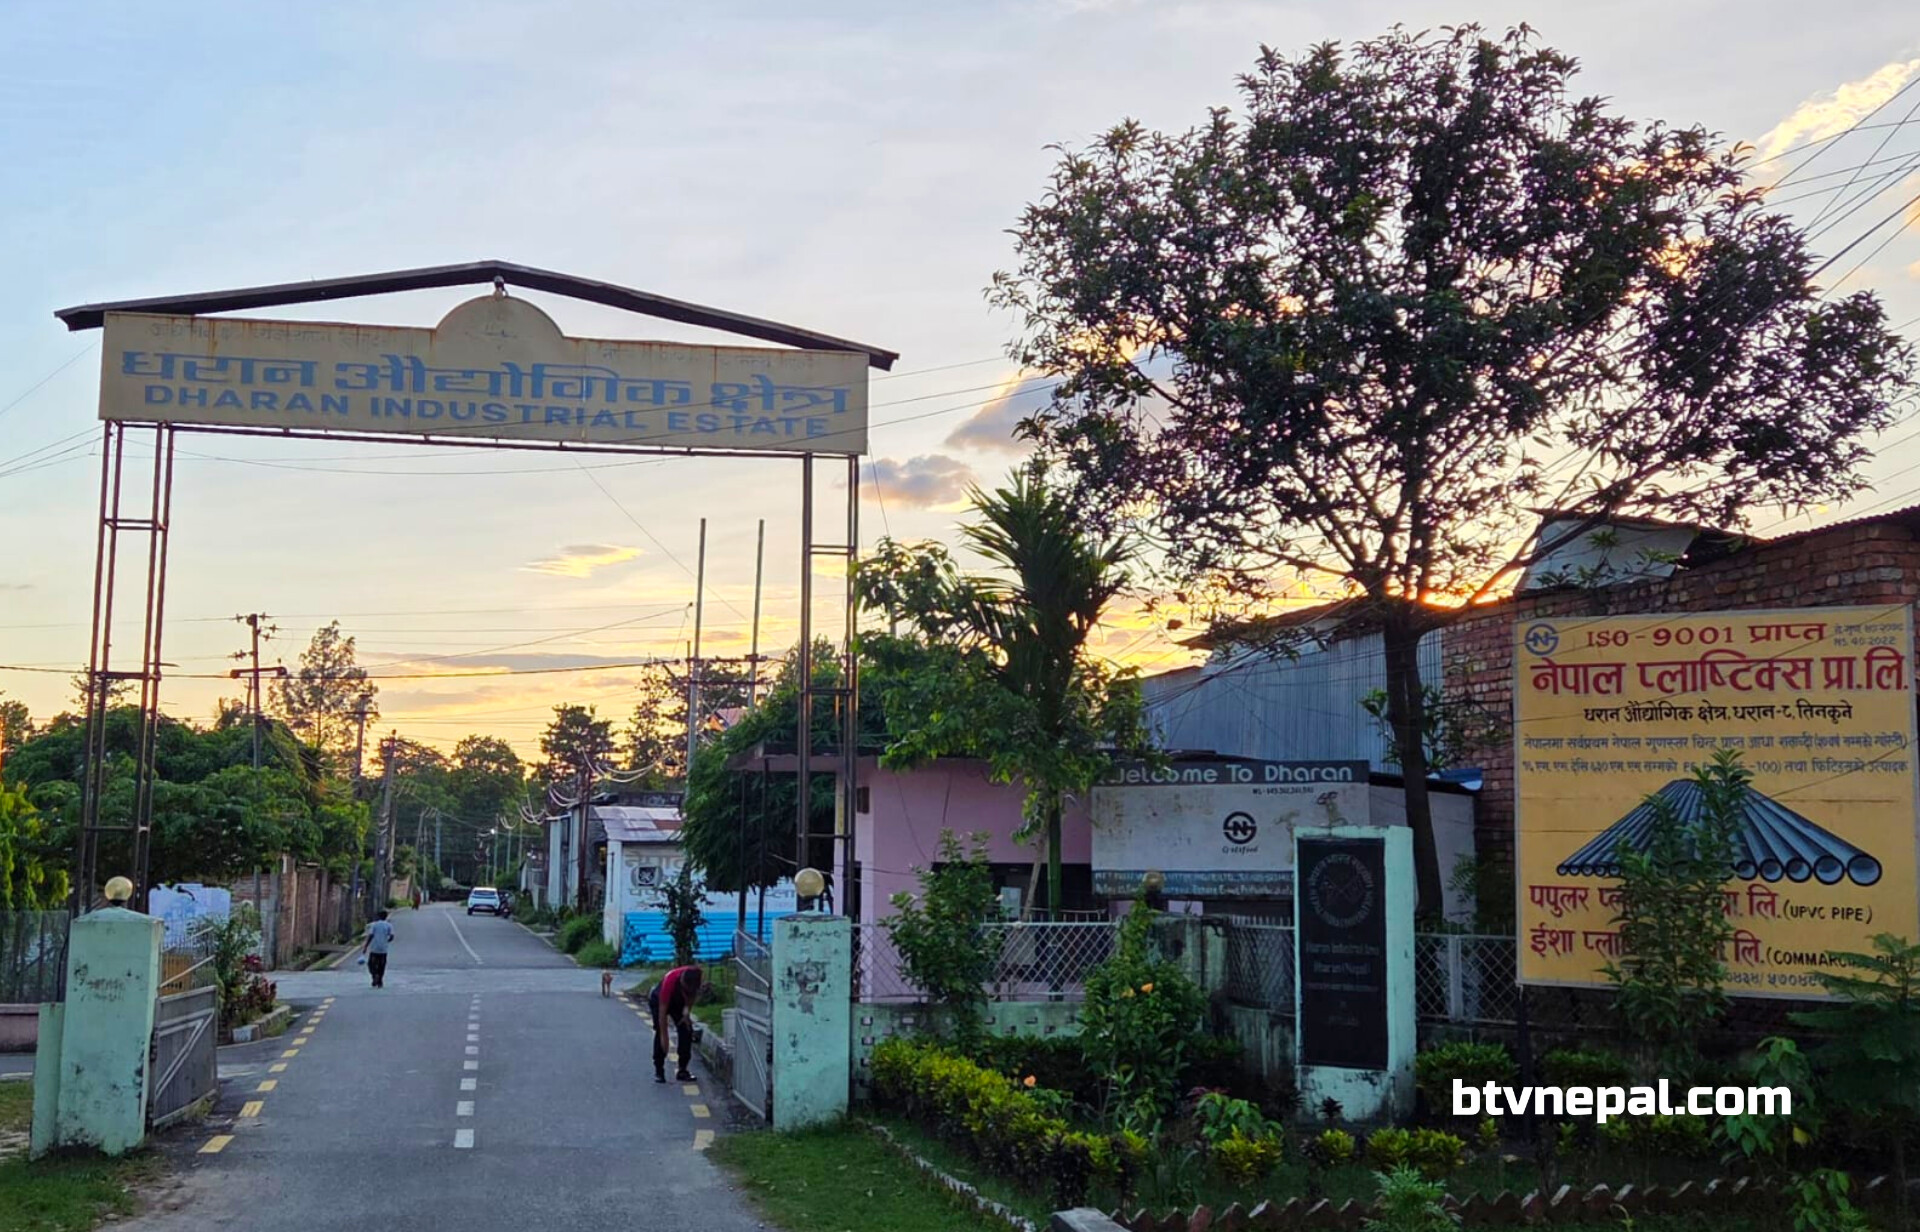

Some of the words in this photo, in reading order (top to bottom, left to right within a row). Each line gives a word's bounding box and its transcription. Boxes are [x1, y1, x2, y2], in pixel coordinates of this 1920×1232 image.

[122, 350, 319, 388] धरान
[143, 384, 349, 416] DHARAN
[370, 396, 649, 430] INDUSTRIAL
[667, 411, 830, 439] ESTATE
[1586, 626, 1629, 647] ISO
[1653, 625, 1735, 647] 9001
[1748, 622, 1828, 644] प्राप्त
[1530, 657, 1627, 695] नेपाल
[1637, 649, 1812, 694] प्लाष्टिक्स
[1584, 706, 1619, 724] धरान
[1225, 763, 1254, 783] To
[1265, 763, 1353, 782] Dharan
[1529, 884, 1589, 917] पपुलर
[1831, 905, 1873, 925] PIPE)
